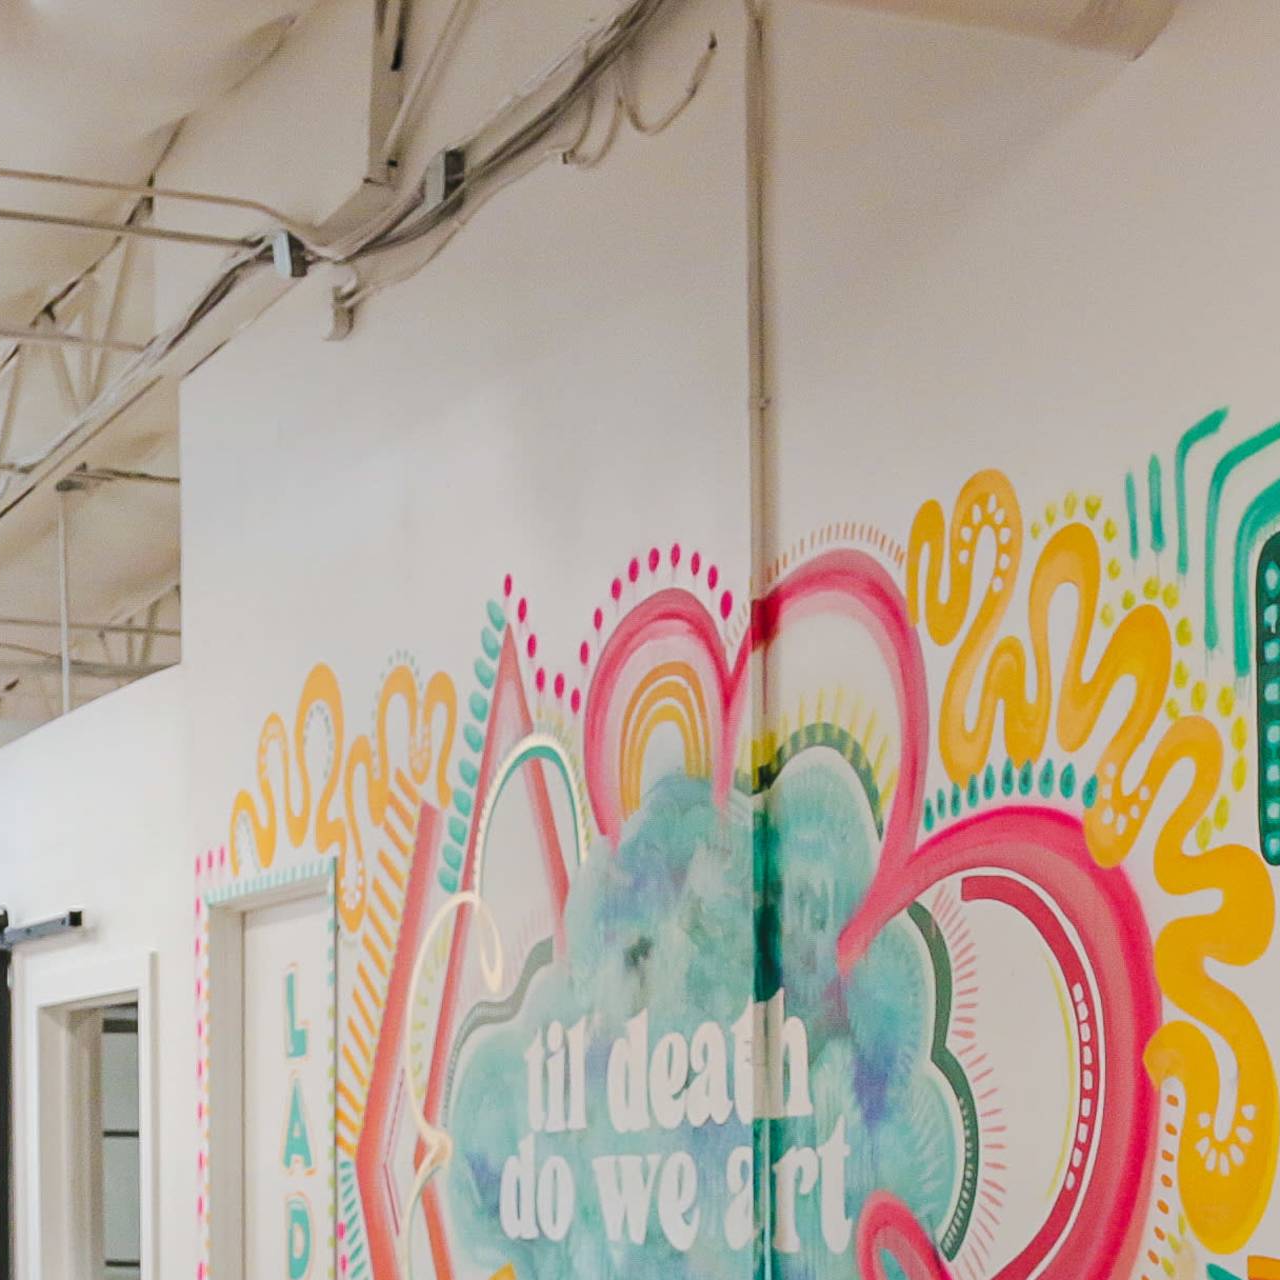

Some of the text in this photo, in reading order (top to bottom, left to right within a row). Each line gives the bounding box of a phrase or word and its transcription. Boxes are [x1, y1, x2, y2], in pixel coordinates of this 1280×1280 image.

[524, 989, 814, 1134] til death
[498, 1115, 853, 1254] do we art
